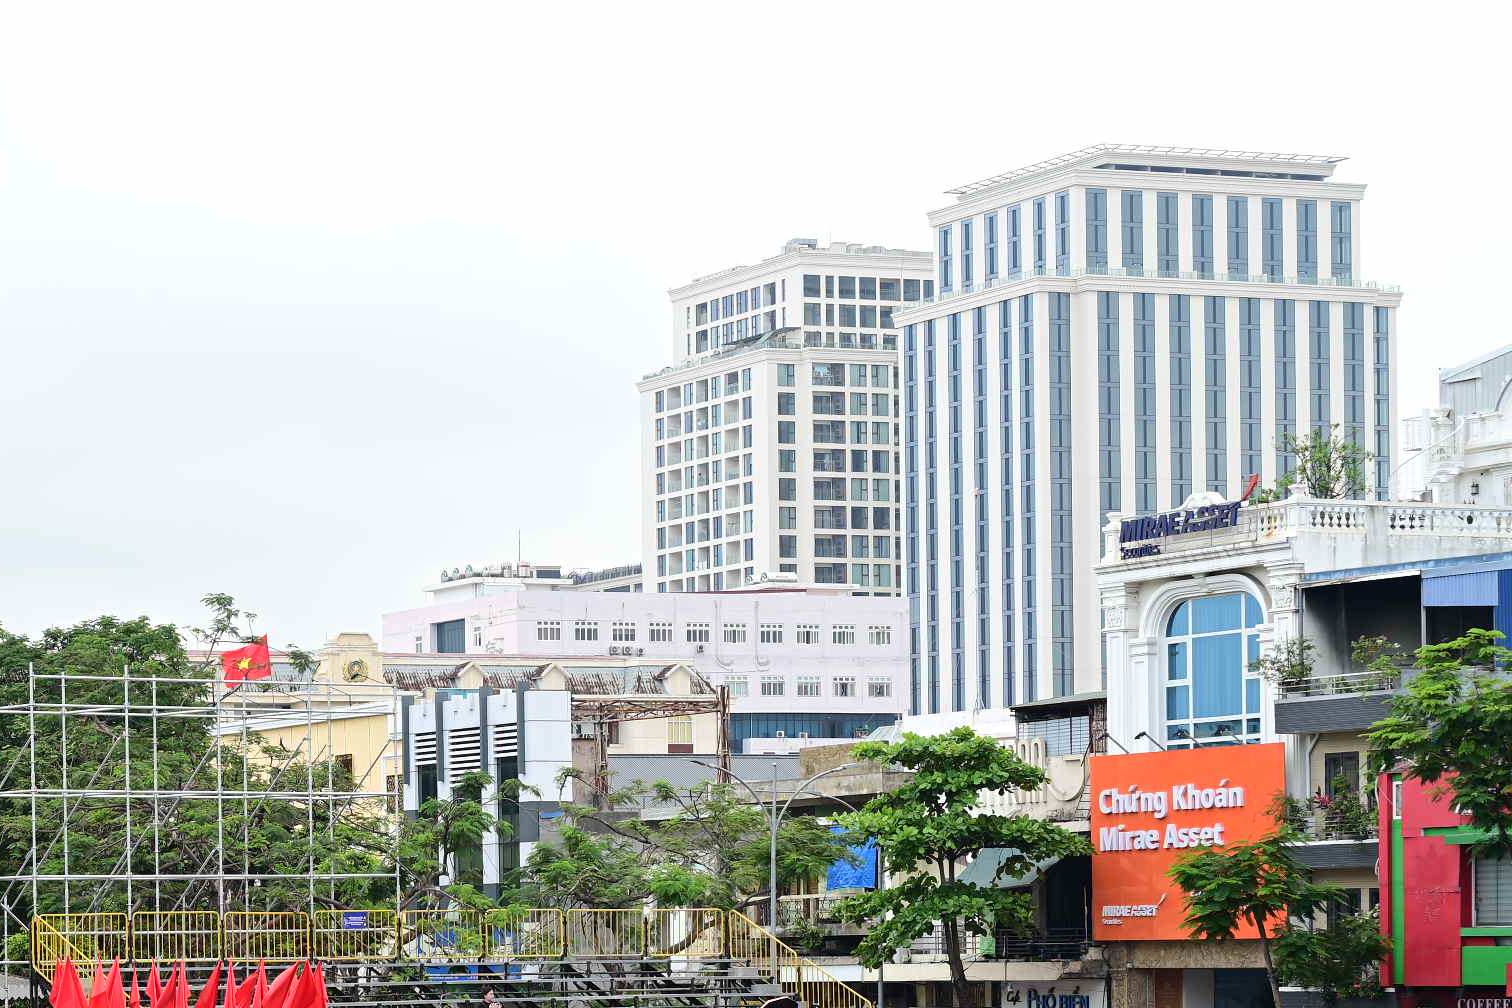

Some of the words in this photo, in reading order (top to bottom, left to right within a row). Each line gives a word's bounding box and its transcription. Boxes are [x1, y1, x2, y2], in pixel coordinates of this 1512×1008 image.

[1120, 511, 1182, 543] MIRAE
[1182, 501, 1241, 533] ASSET
[1099, 784, 1169, 819] Chứng
[1172, 778, 1245, 810] Khoán
[1099, 823, 1160, 851] Mirae
[1163, 822, 1225, 849] Asset
